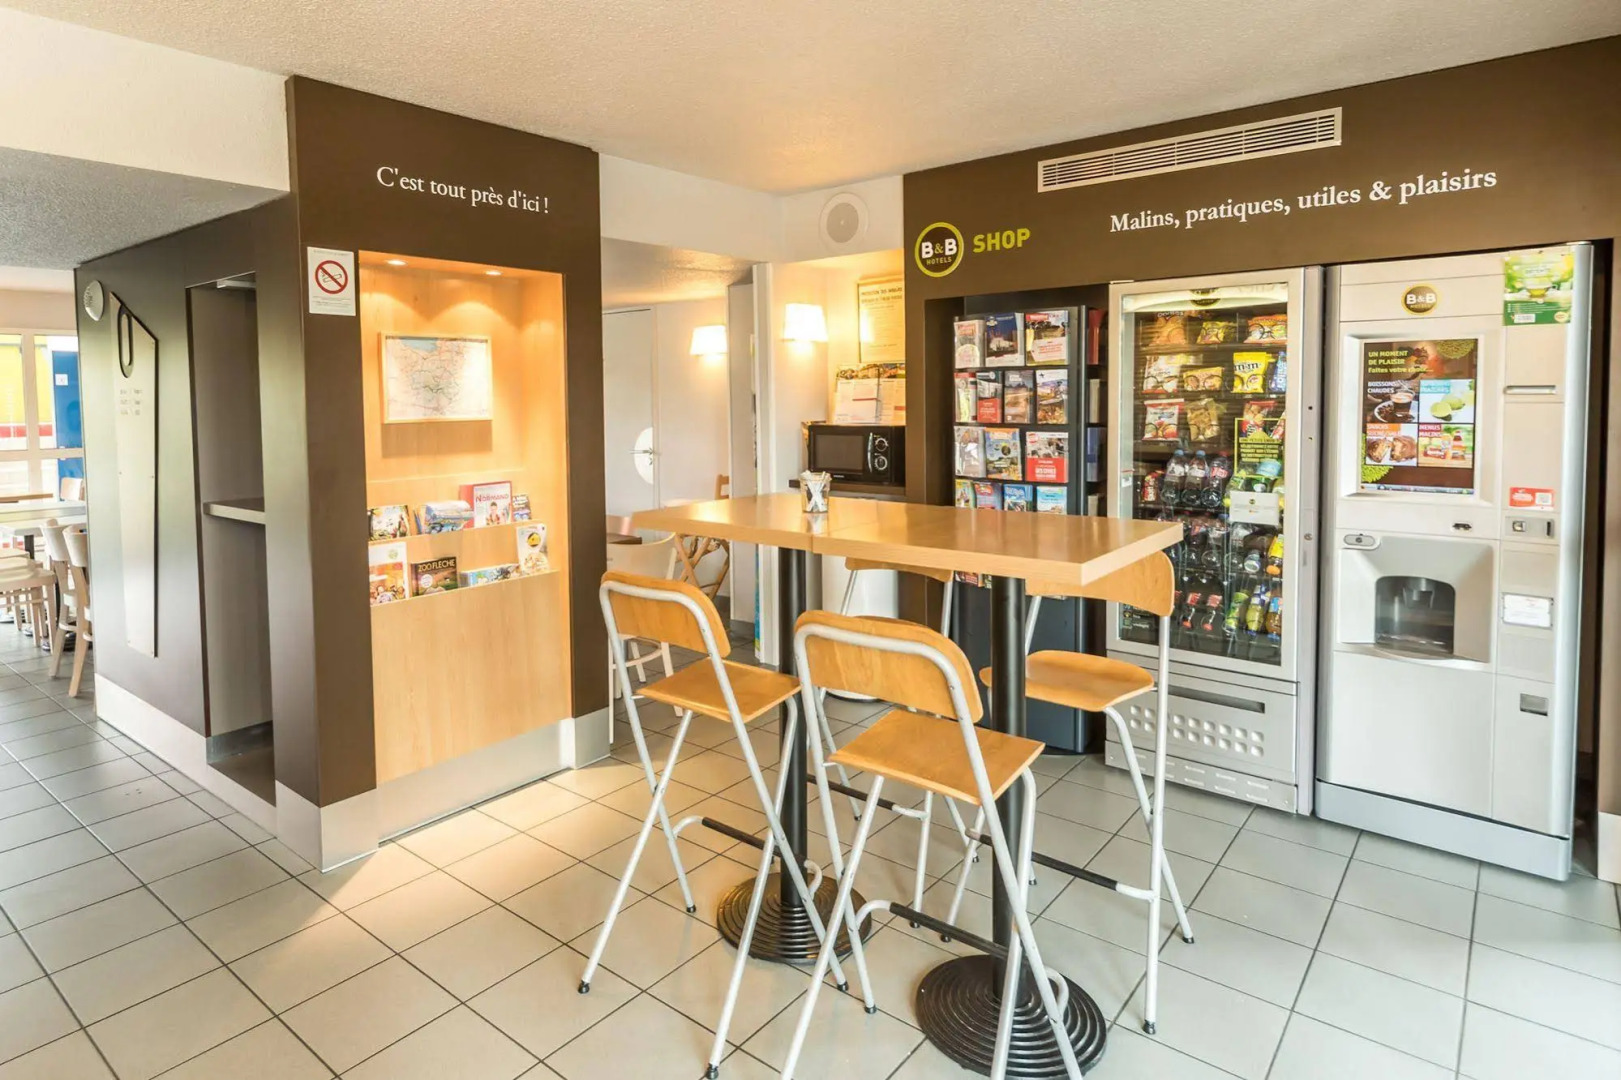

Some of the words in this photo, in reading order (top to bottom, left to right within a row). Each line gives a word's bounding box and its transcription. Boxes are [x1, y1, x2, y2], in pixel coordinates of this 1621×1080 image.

[377, 166, 424, 192] C'est
[430, 180, 466, 199] tout
[471, 187, 503, 207] près
[508, 190, 540, 212] d'ici
[1110, 211, 1180, 233] Malins,
[1185, 199, 1291, 229] pratiques,
[1297, 185, 1361, 209] utiles
[1369, 180, 1392, 202] &
[1399, 168, 1497, 205] plaisirs
[921, 238, 958, 259] B&B
[973, 228, 1031, 253] SHOP
[926, 256, 952, 266] HOTELS
